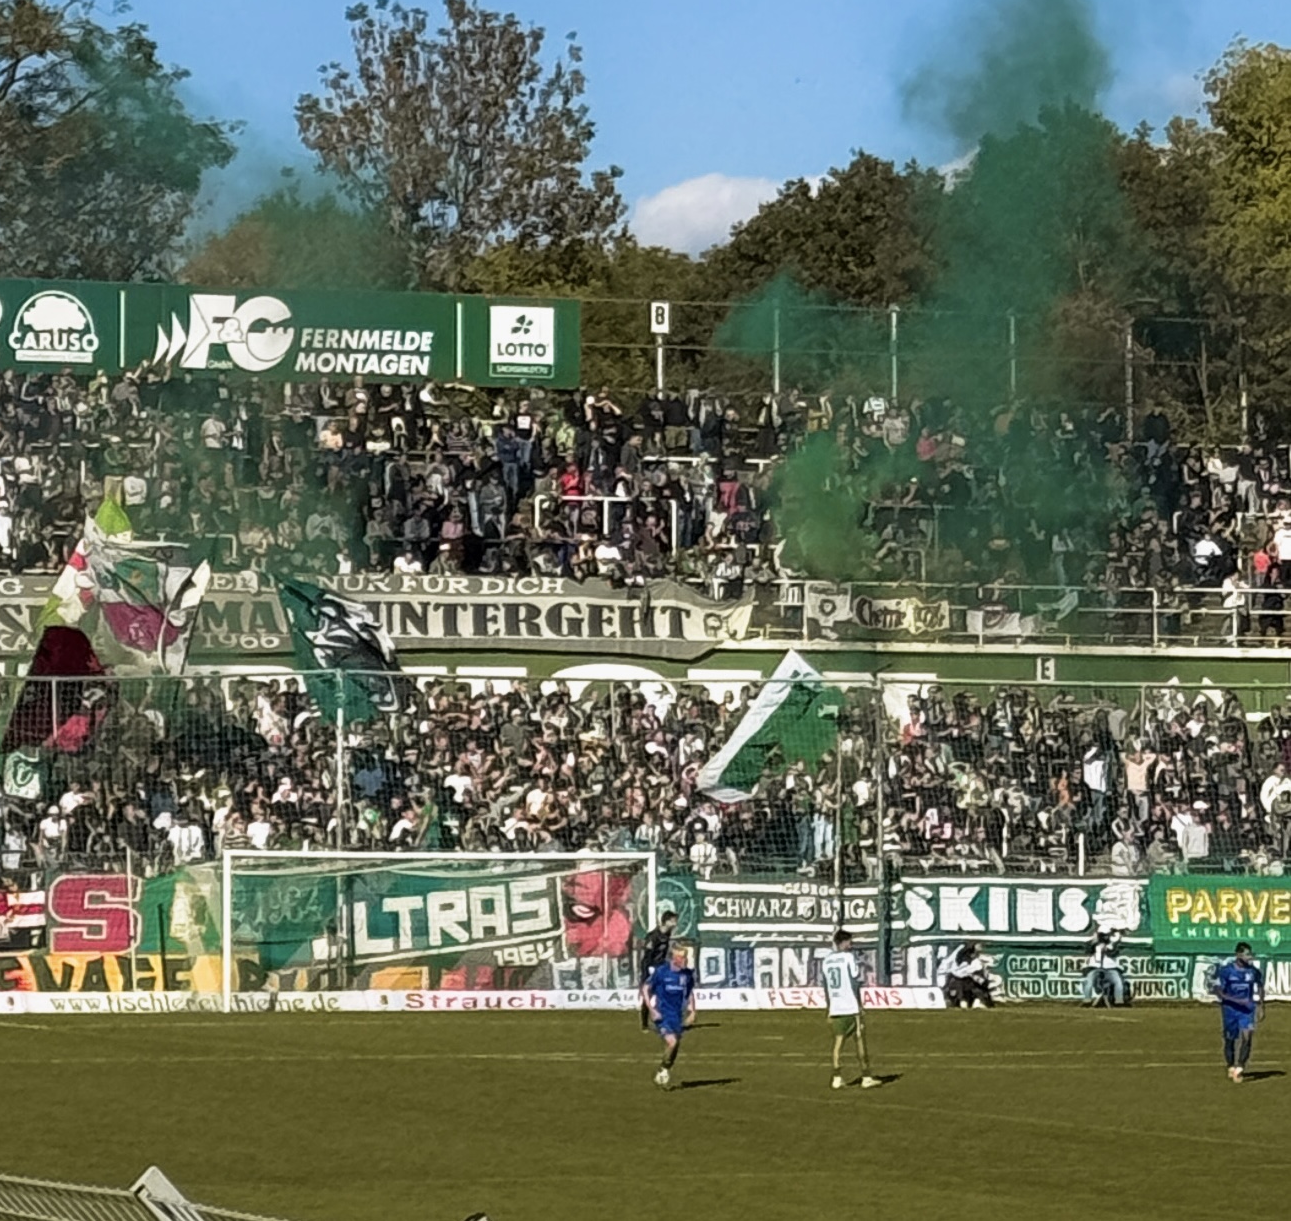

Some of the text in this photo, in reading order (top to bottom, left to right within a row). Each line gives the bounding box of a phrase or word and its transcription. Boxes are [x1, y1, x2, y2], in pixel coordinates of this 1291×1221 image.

[8, 331, 100, 352] CARUSO
[300, 327, 435, 352] FERNMELDE
[497, 342, 547, 357] LOTTO
[294, 351, 431, 376] MONTAGEN
[481, 577, 565, 596] DICH
[202, 633, 281, 649] 1966
[703, 896, 794, 918] SCHWARZ
[904, 884, 1090, 933] SKINS
[1166, 887, 1291, 924] PARVE
[493, 940, 554, 966] 1964
[1009, 979, 1043, 997] UND
